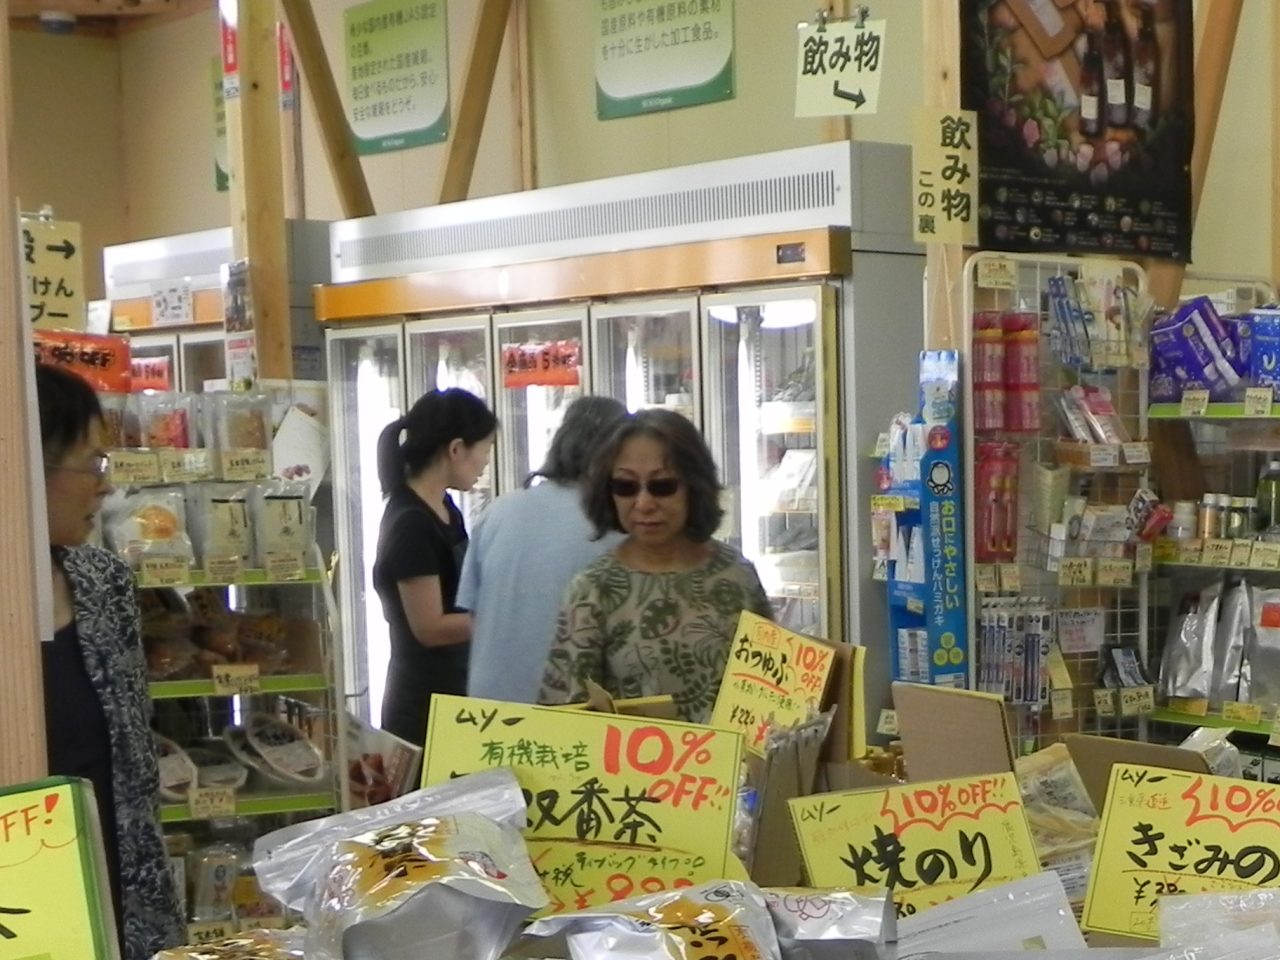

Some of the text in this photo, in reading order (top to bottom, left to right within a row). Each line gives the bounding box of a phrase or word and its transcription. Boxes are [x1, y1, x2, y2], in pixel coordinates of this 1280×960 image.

[802, 32, 880, 76] 飲み物
[940, 115, 971, 223] 飲み物
[917, 170, 937, 235] この裏
[795, 643, 829, 673] 10%
[481, 738, 591, 772] 有機栽培
[602, 724, 718, 778] 10%
[839, 824, 994, 894] 焼のり
